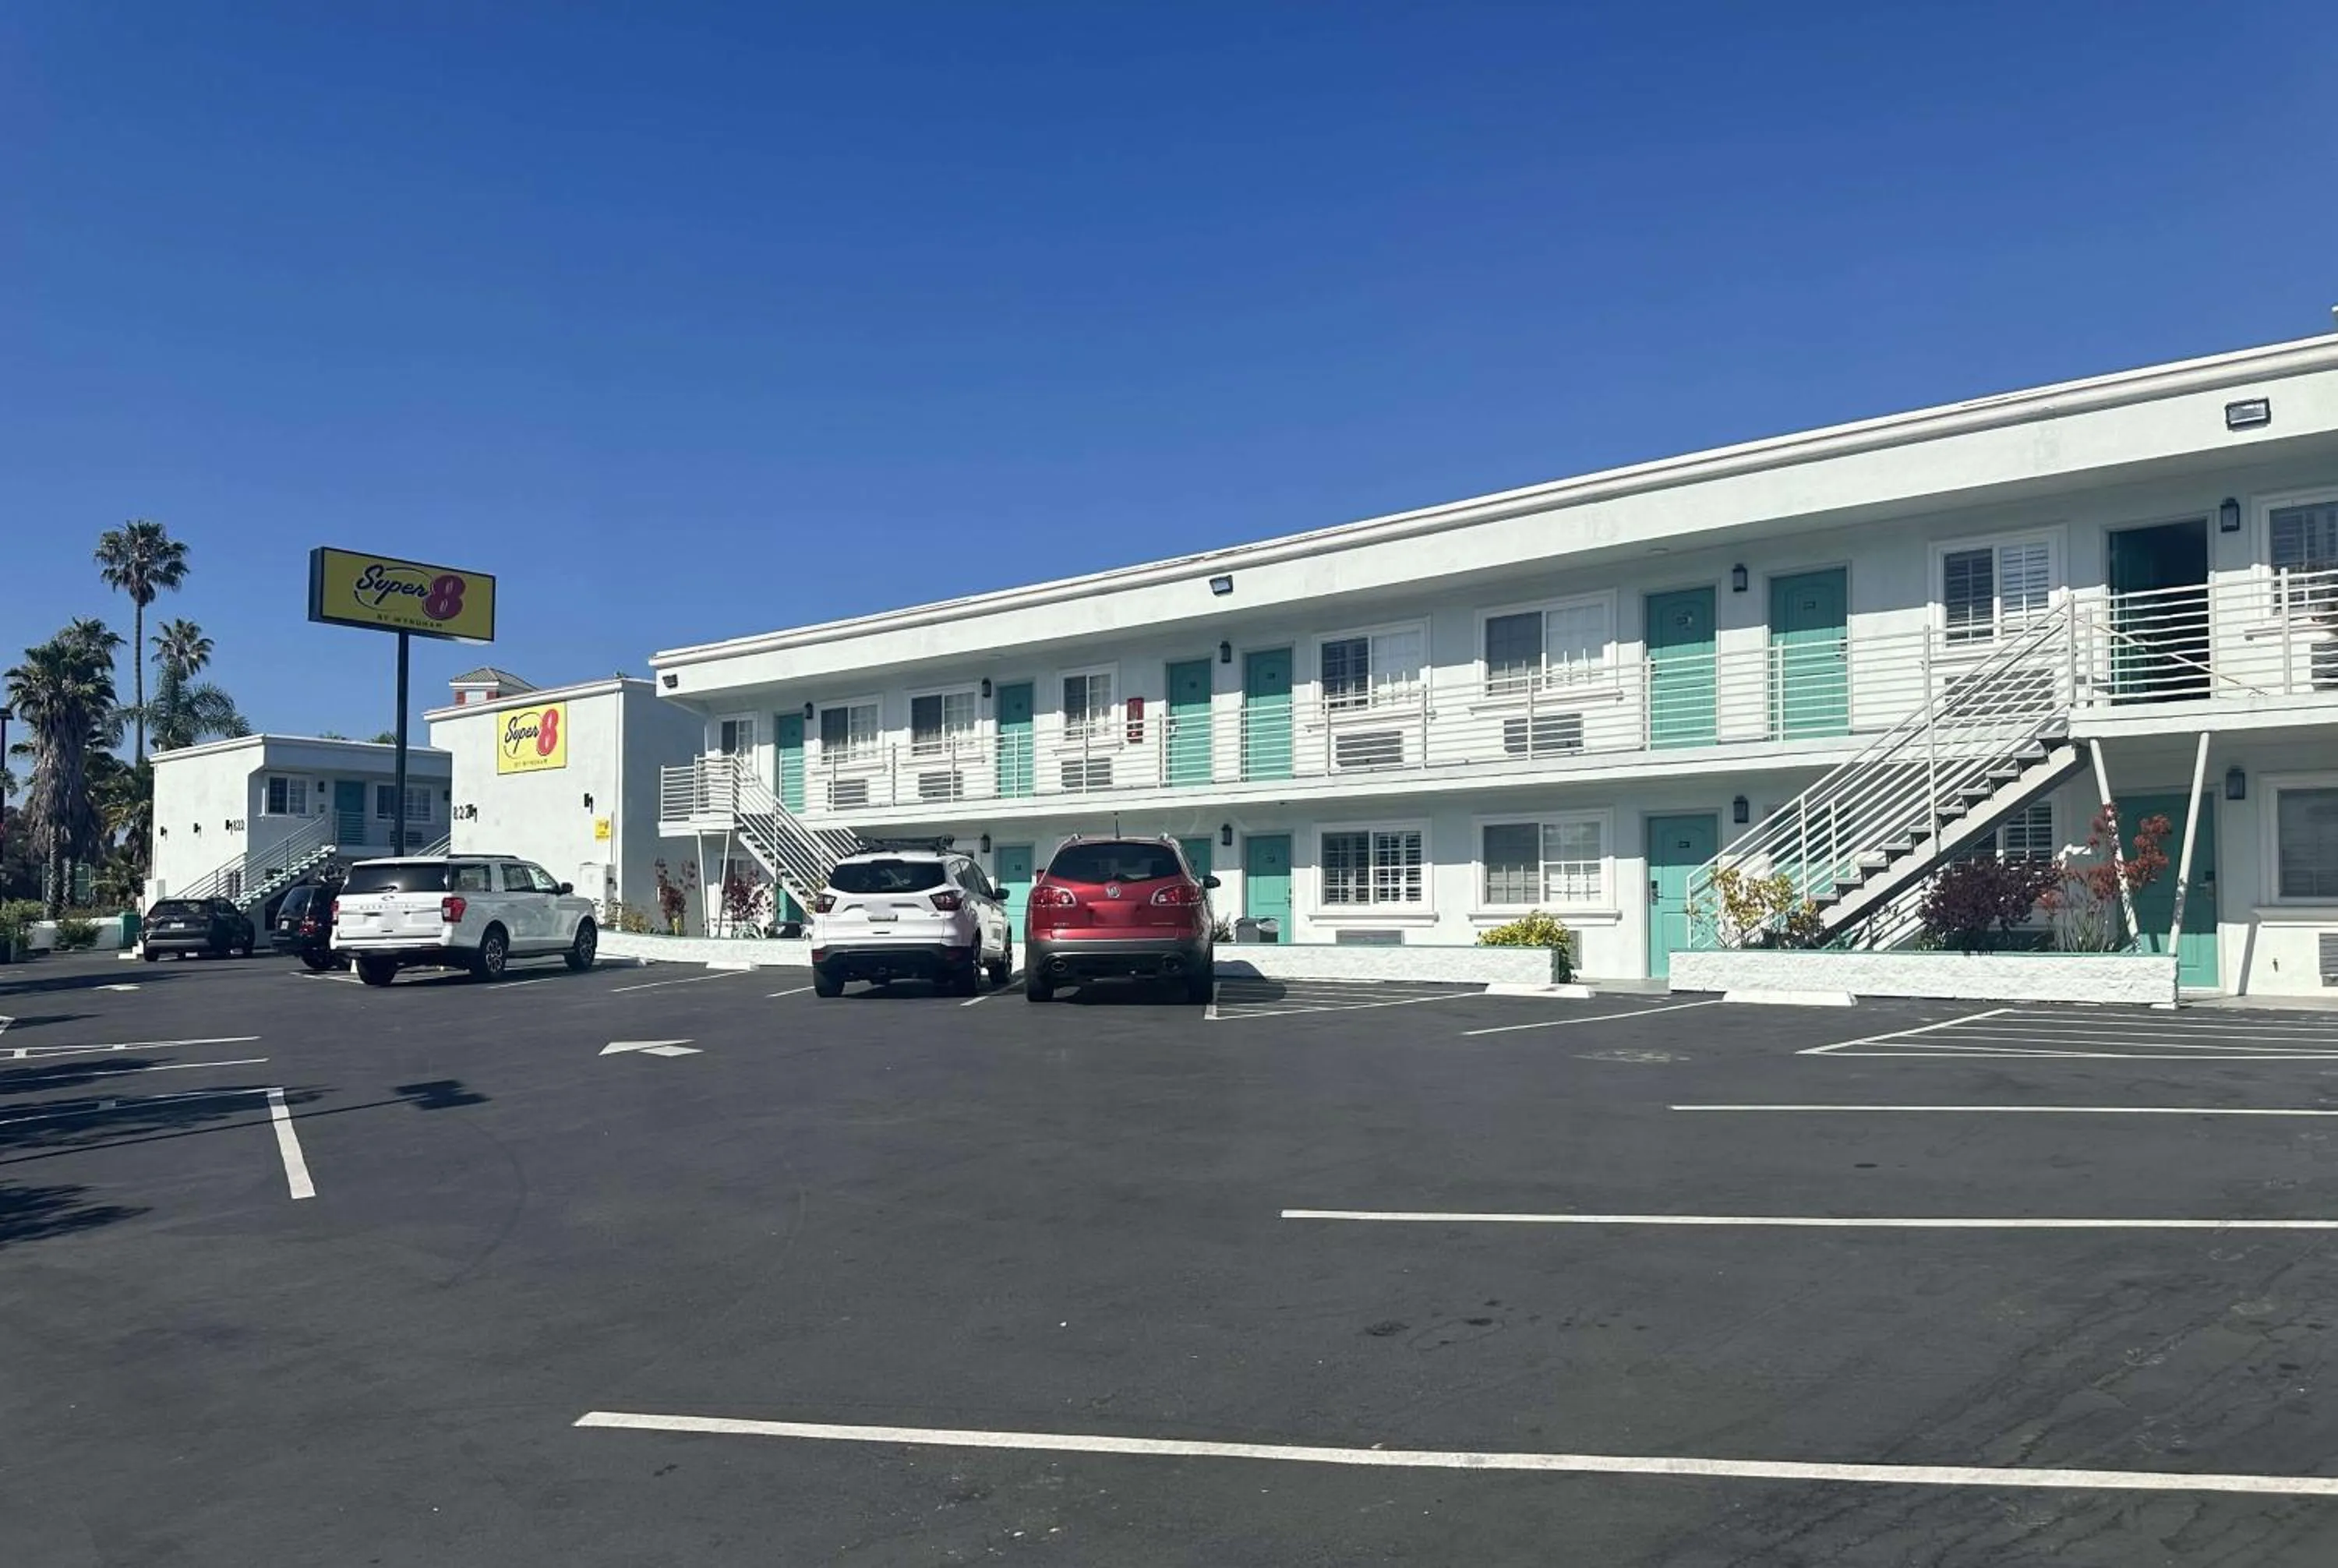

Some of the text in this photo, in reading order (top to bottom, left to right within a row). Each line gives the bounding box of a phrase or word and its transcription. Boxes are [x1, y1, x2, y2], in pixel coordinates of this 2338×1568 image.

[355, 564, 467, 620] Super 8
[504, 708, 559, 757] Super 8
